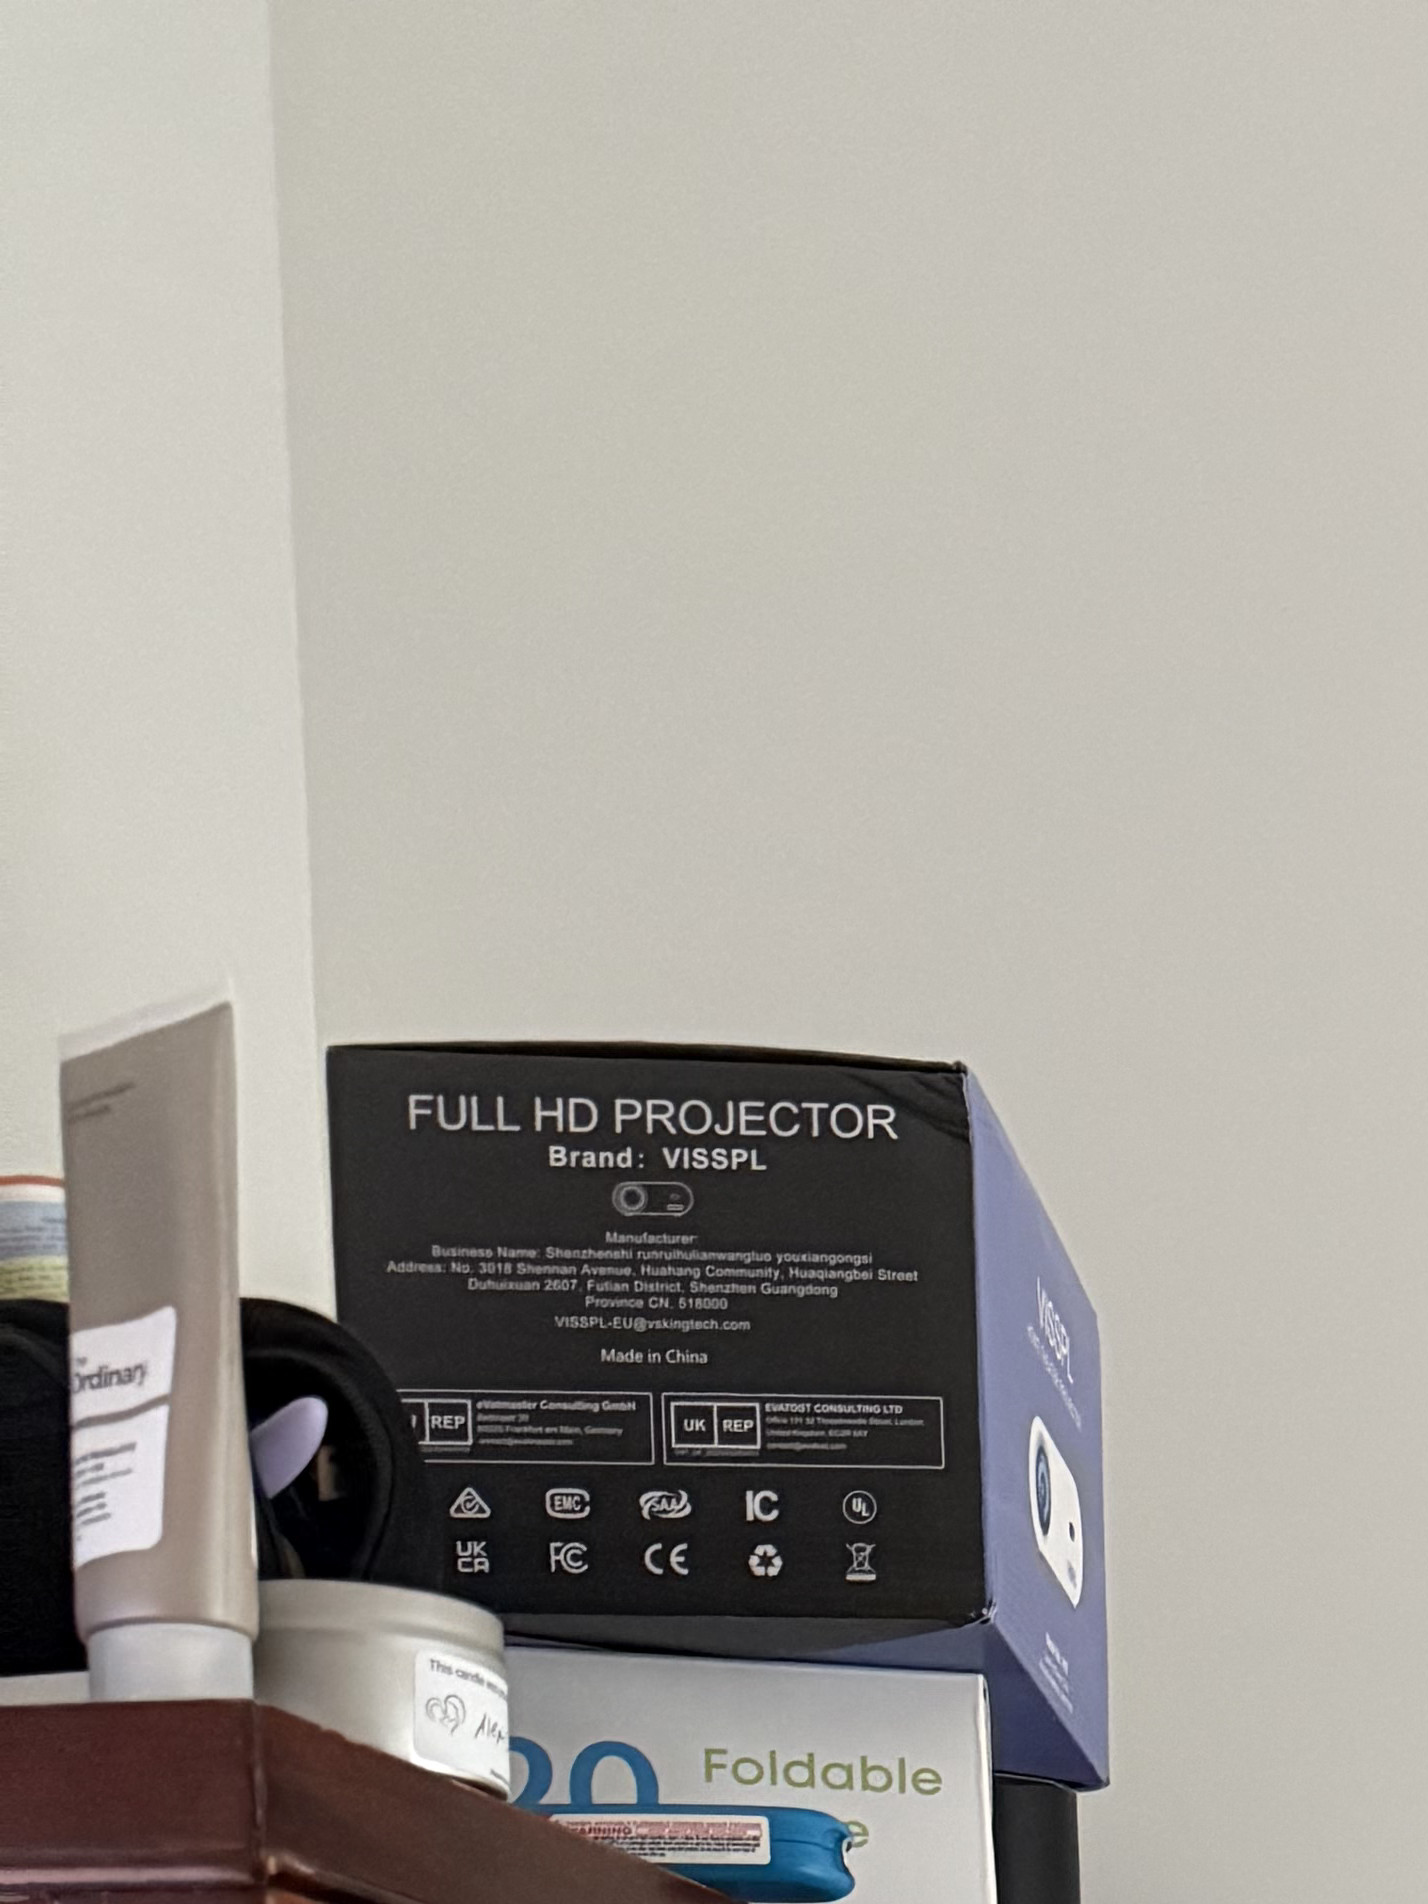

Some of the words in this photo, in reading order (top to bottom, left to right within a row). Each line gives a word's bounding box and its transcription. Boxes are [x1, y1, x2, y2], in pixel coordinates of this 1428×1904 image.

[408, 1094, 521, 1132] FULL
[533, 1096, 599, 1134] HD
[613, 1099, 900, 1140] PROJECTOR
[548, 1144, 645, 1169] Brand:
[662, 1146, 768, 1171] VISSPL
[431, 1244, 494, 1258] Business
[497, 1246, 540, 1259] Name:
[516, 1262, 577, 1276] Shennan
[641, 1264, 701, 1279] Huahang
[705, 1265, 785, 1281] Community,
[788, 1266, 874, 1282] Huaqiangbei
[877, 1268, 919, 1283] Street
[586, 1280, 630, 1293] Futian
[689, 1281, 757, 1295] Shenzhen
[760, 1282, 839, 1298] Guangdong
[584, 1295, 645, 1309] Province
[600, 1348, 643, 1364] Made
[646, 1348, 662, 1364] in
[665, 1348, 709, 1365] China
[813, 1403, 881, 1415] CONSULTING
[882, 1404, 904, 1415] LTD
[430, 1414, 466, 1430] REP
[683, 1418, 707, 1432] UK
[721, 1419, 755, 1433] REP
[553, 1494, 582, 1512] EMC
[745, 1489, 780, 1522] IC
[851, 1497, 870, 1518] UL
[455, 1540, 488, 1557] UK
[643, 1542, 690, 1576] CE
[703, 1747, 943, 1796] Foldable
